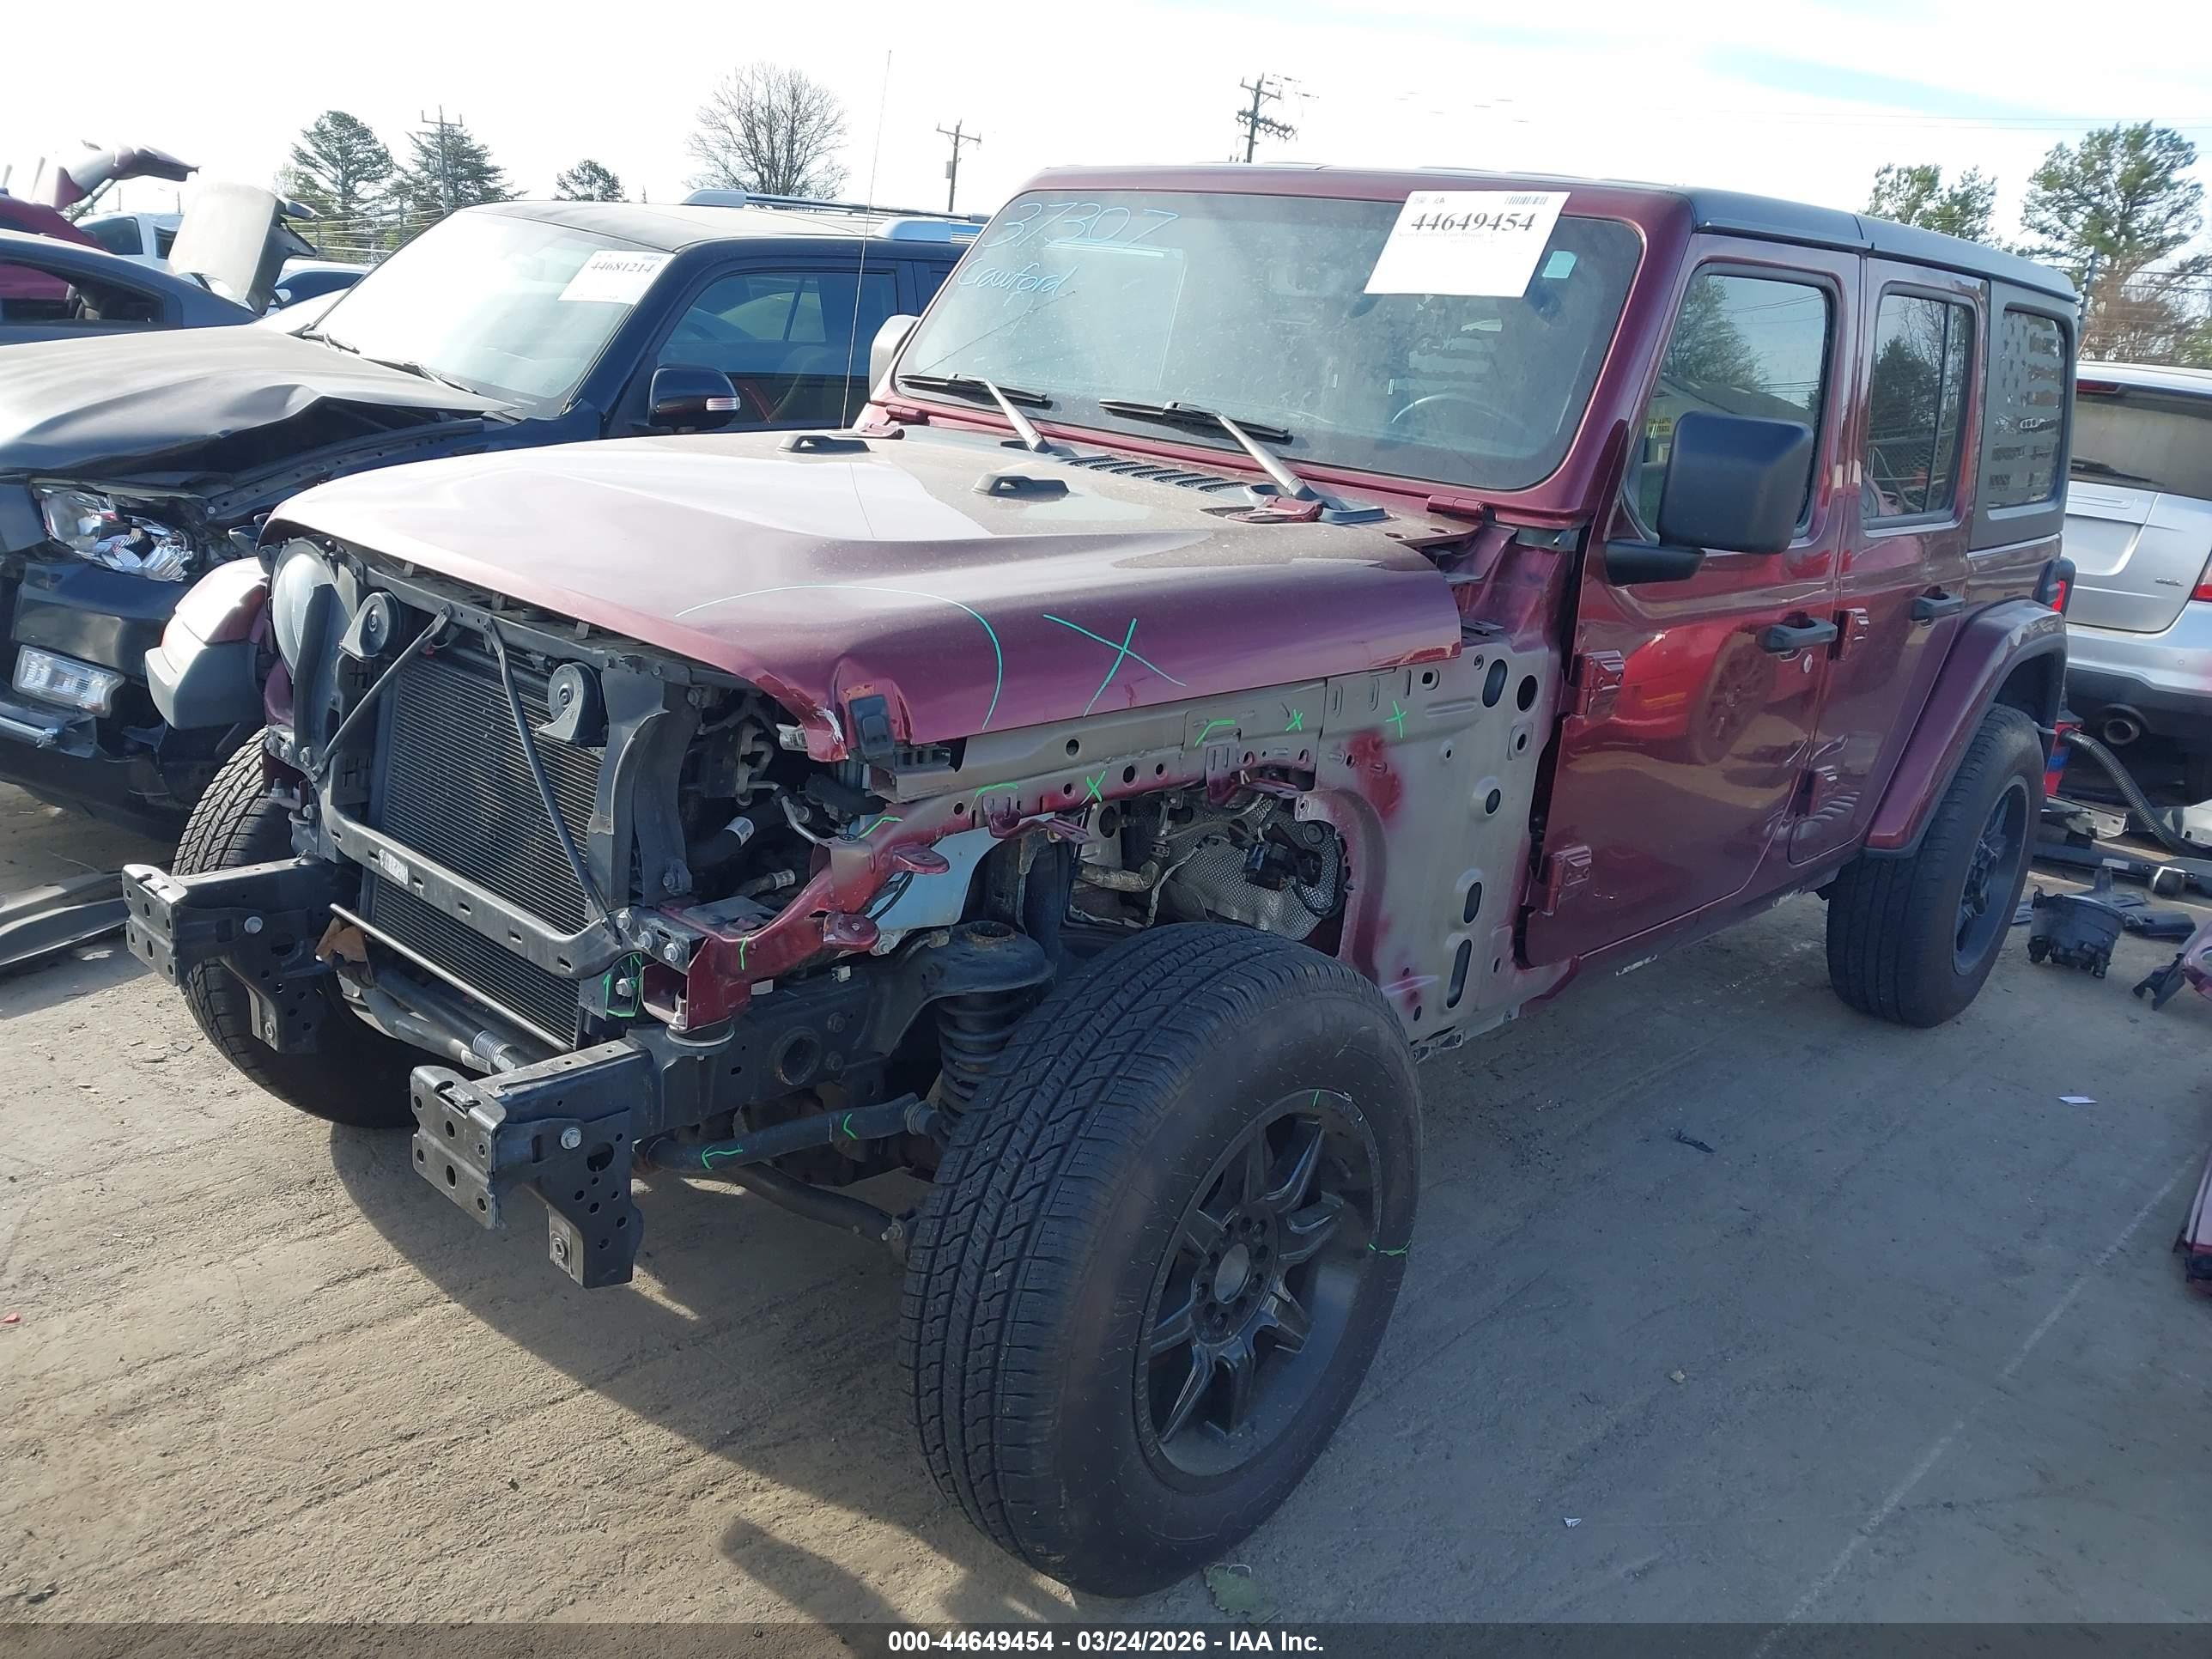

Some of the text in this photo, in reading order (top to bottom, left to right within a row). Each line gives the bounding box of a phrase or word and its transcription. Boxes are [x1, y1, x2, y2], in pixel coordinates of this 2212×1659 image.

[981, 202, 1180, 248] 37307
[1411, 212, 1536, 231] 44649454
[957, 258, 1078, 295] Crawford
